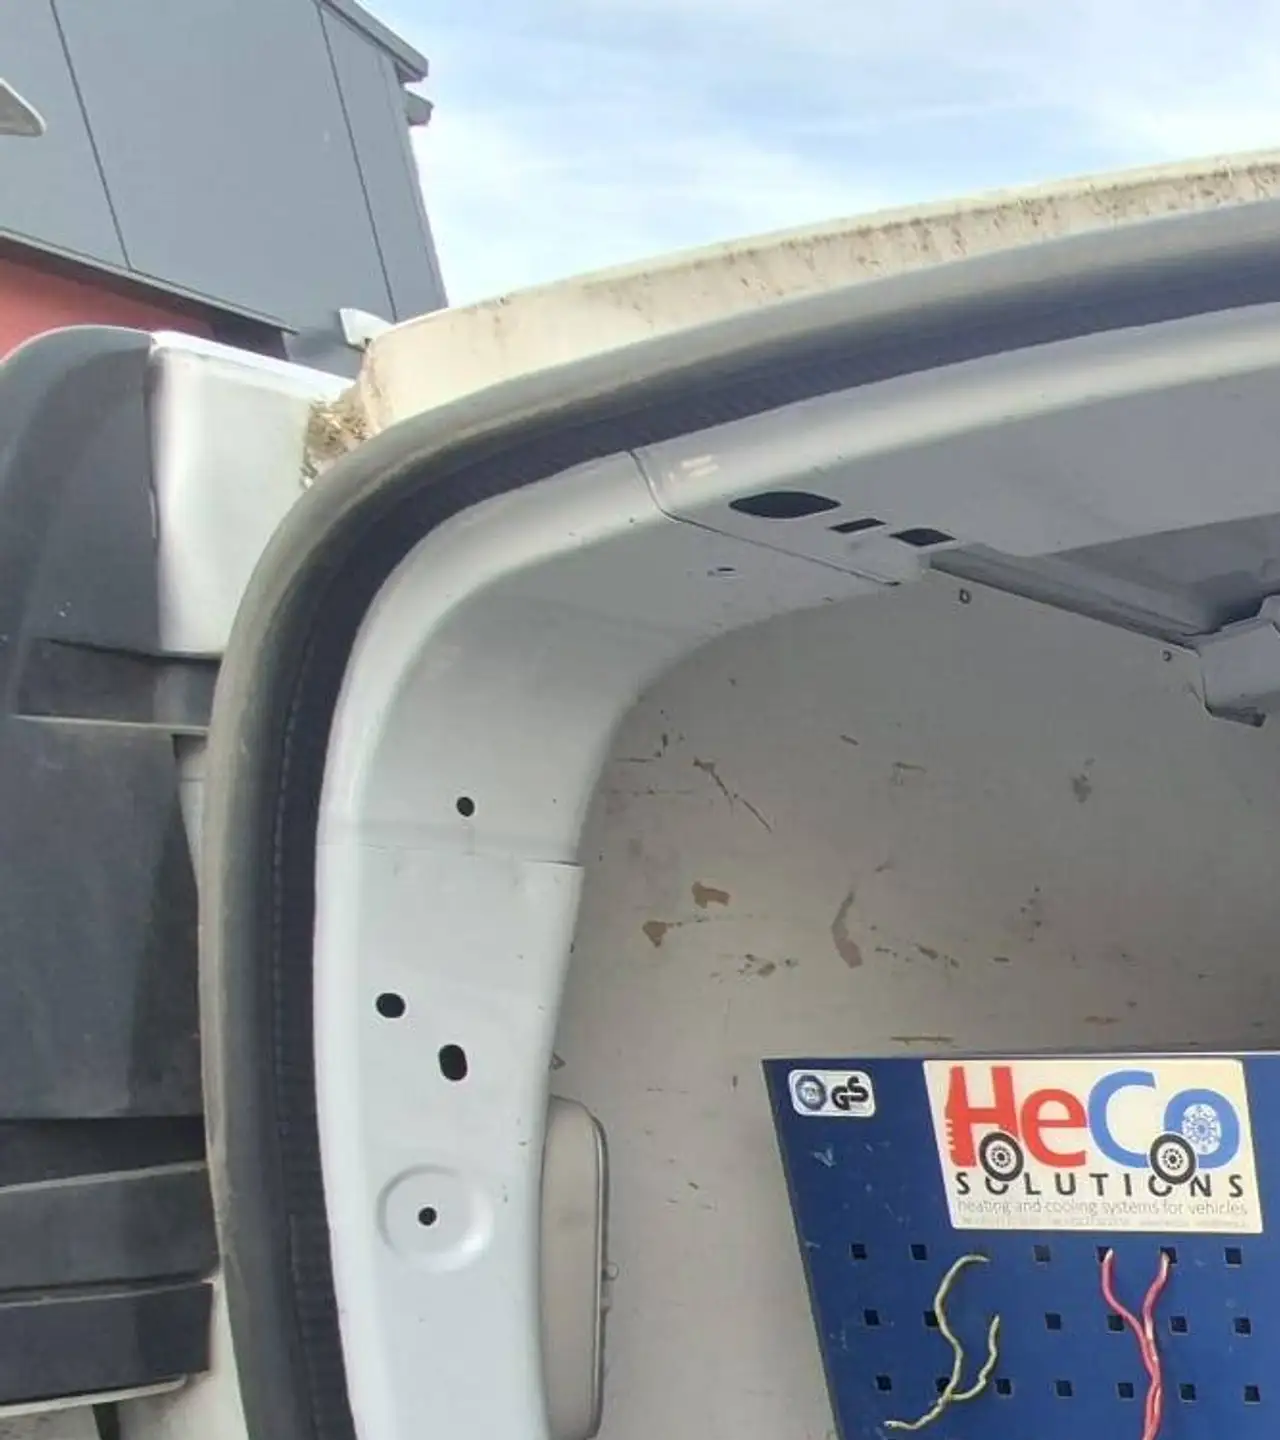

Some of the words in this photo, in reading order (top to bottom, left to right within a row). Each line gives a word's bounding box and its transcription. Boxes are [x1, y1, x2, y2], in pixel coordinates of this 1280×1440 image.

[831, 1076, 869, 1111] GS
[945, 1066, 1240, 1169] HeCo
[956, 1172, 1244, 1197] SOLUTIONS
[957, 1199, 1011, 1216] heating
[1017, 1199, 1041, 1213] and
[1045, 1199, 1098, 1216] cooling
[1102, 1201, 1159, 1216] systems
[1163, 1201, 1184, 1214] for
[1187, 1201, 1247, 1215] vehicles
